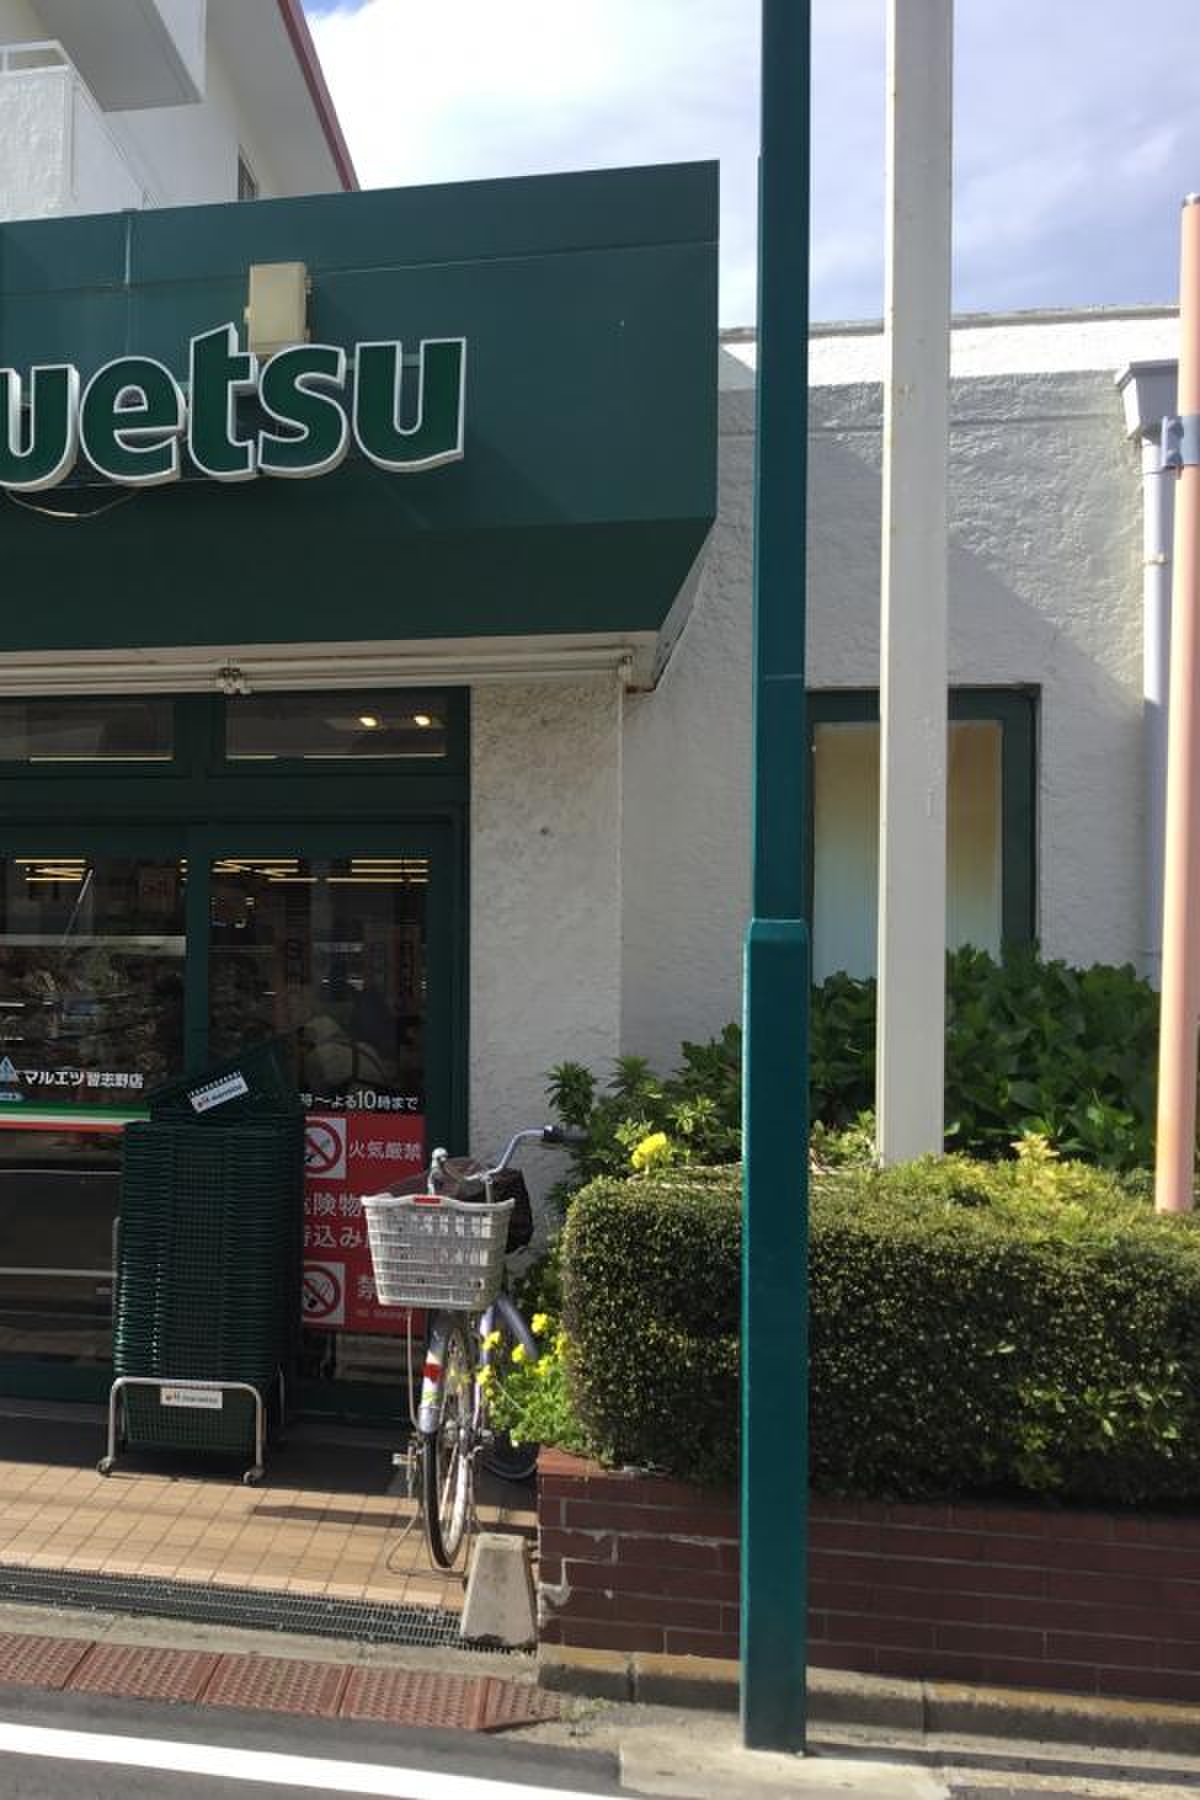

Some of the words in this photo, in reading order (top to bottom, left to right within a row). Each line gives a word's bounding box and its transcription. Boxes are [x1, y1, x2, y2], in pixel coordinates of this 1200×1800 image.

[348, 1140, 421, 1160] 火気厳禁
[304, 1223, 367, 1249] 込み
